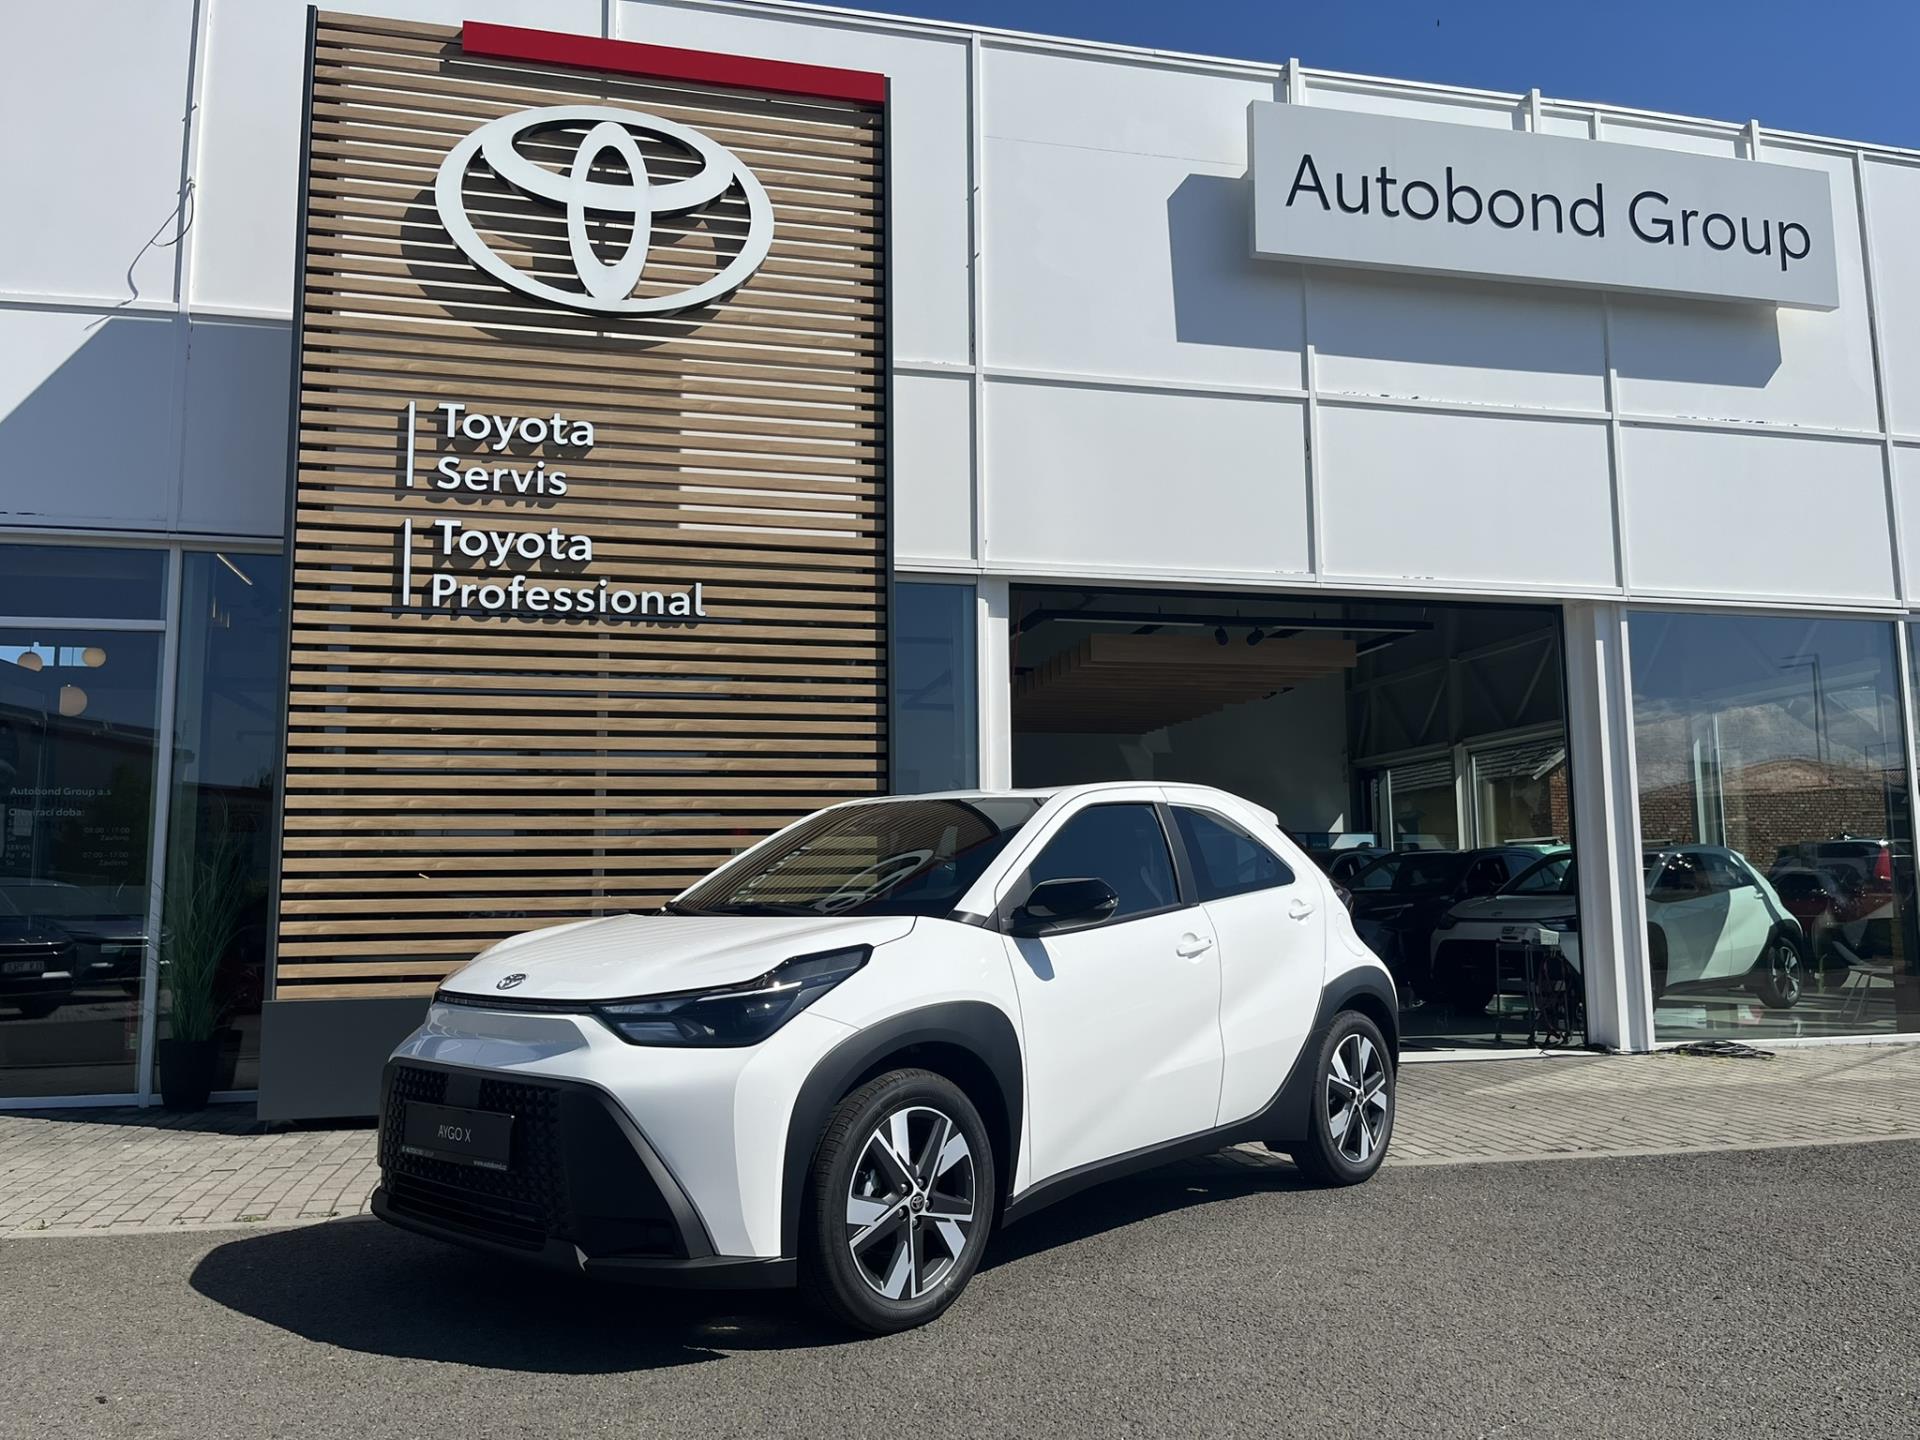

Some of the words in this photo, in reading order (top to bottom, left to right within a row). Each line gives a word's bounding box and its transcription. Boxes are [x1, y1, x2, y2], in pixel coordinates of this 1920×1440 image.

[1285, 153, 1605, 238] Autobond
[1628, 190, 1811, 272] Group
[438, 402, 595, 451] Toyota
[436, 456, 568, 496] Servis
[434, 519, 593, 567] Toyota
[432, 574, 706, 617] Professional
[10, 787, 61, 796] Autobond
[63, 787, 96, 798] Group
[438, 1125, 463, 1142] AYGO
[464, 1128, 472, 1143] X
